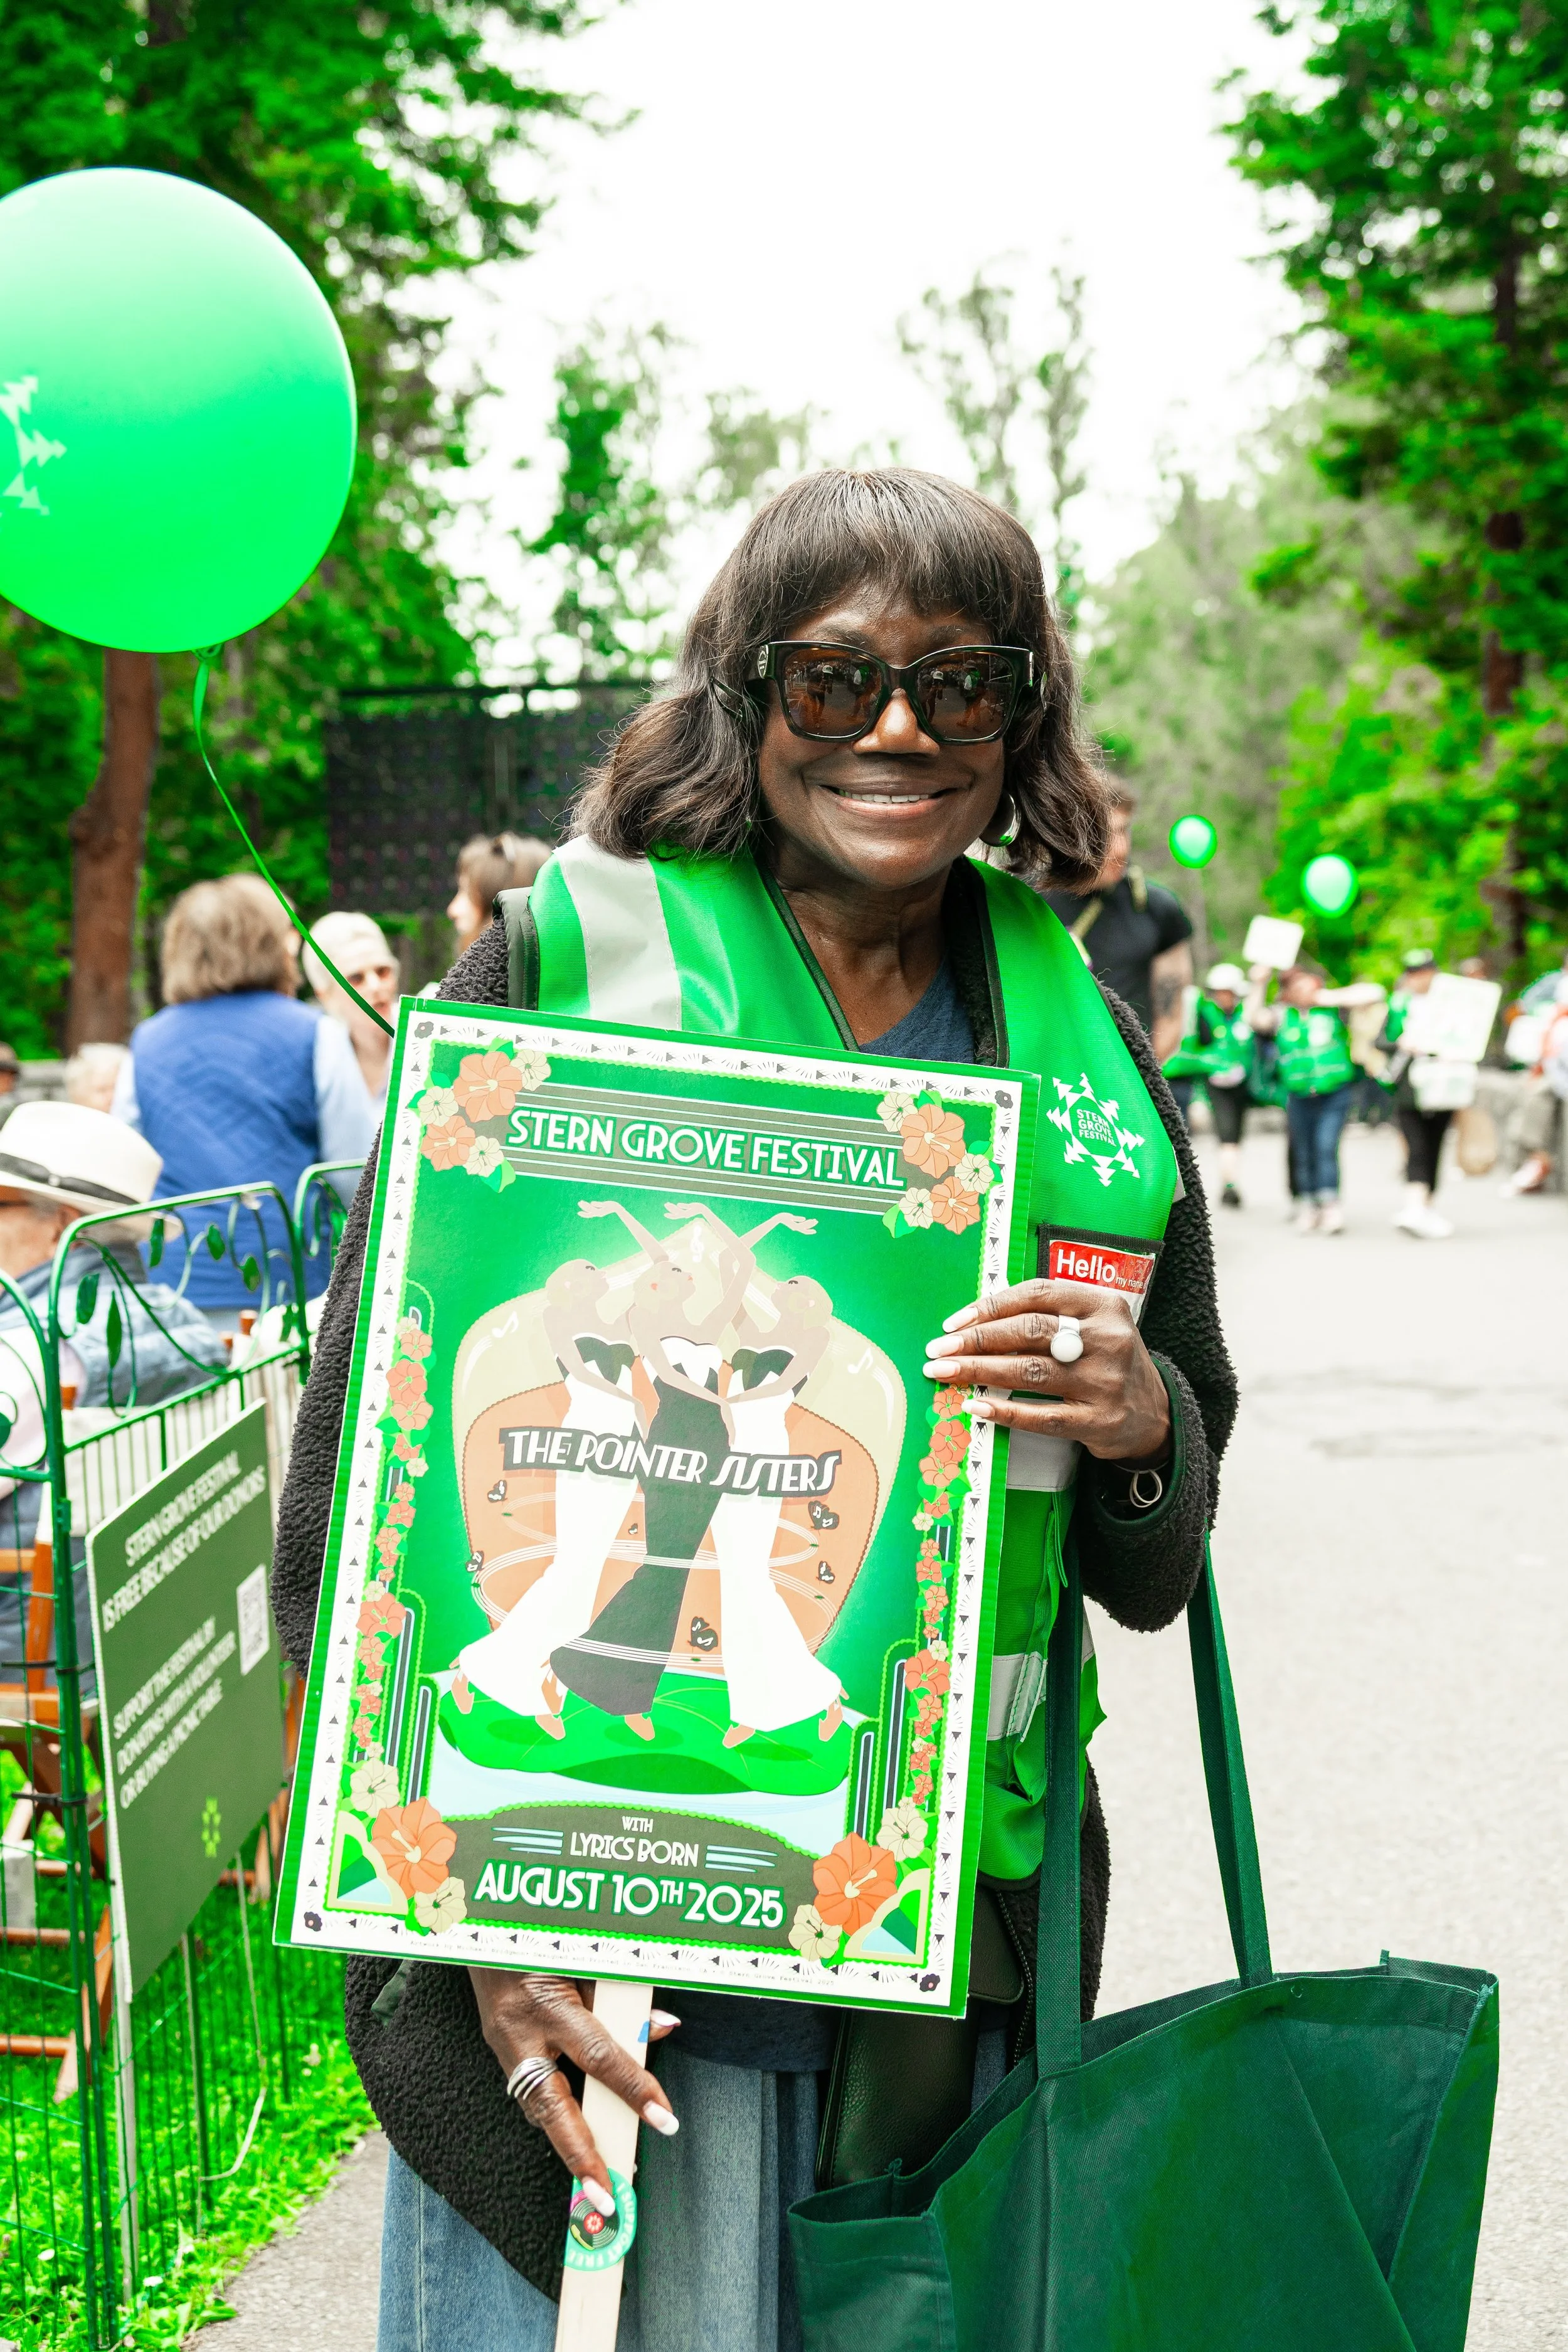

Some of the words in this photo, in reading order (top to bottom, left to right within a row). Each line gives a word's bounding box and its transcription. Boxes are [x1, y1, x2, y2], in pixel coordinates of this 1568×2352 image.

[1076, 1109, 1110, 1130] STERN
[1078, 1119, 1113, 1139] GROVE
[1079, 1129, 1116, 1147] FESTIVAL
[508, 1110, 613, 1155] STERN
[621, 1123, 743, 1168] GROVE
[751, 1136, 905, 1187] FESTIVAL
[1056, 1249, 1116, 1283] Hello
[1116, 1276, 1127, 1288] my
[1128, 1279, 1143, 1289] name
[508, 1430, 572, 1465] THE
[575, 1434, 709, 1484] POINTER
[709, 1454, 840, 1492] SISTERS
[125, 1513, 162, 1567] STERN
[160, 1485, 197, 1535] GROVE
[194, 1453, 240, 1508] FESTIVAL
[113, 1574, 142, 1621] FREE
[622, 1815, 654, 1833] WITH
[569, 1831, 635, 1860] LYRICS
[637, 1838, 700, 1868] BORN
[474, 1862, 605, 1913] AUGUST
[612, 1873, 684, 1915] 10TH
[684, 1883, 784, 1929] 2025
[780, 1976, 813, 1984] Festival
[609, 2193, 635, 2260] SUPPORT
[568, 2250, 604, 2267] FREE
